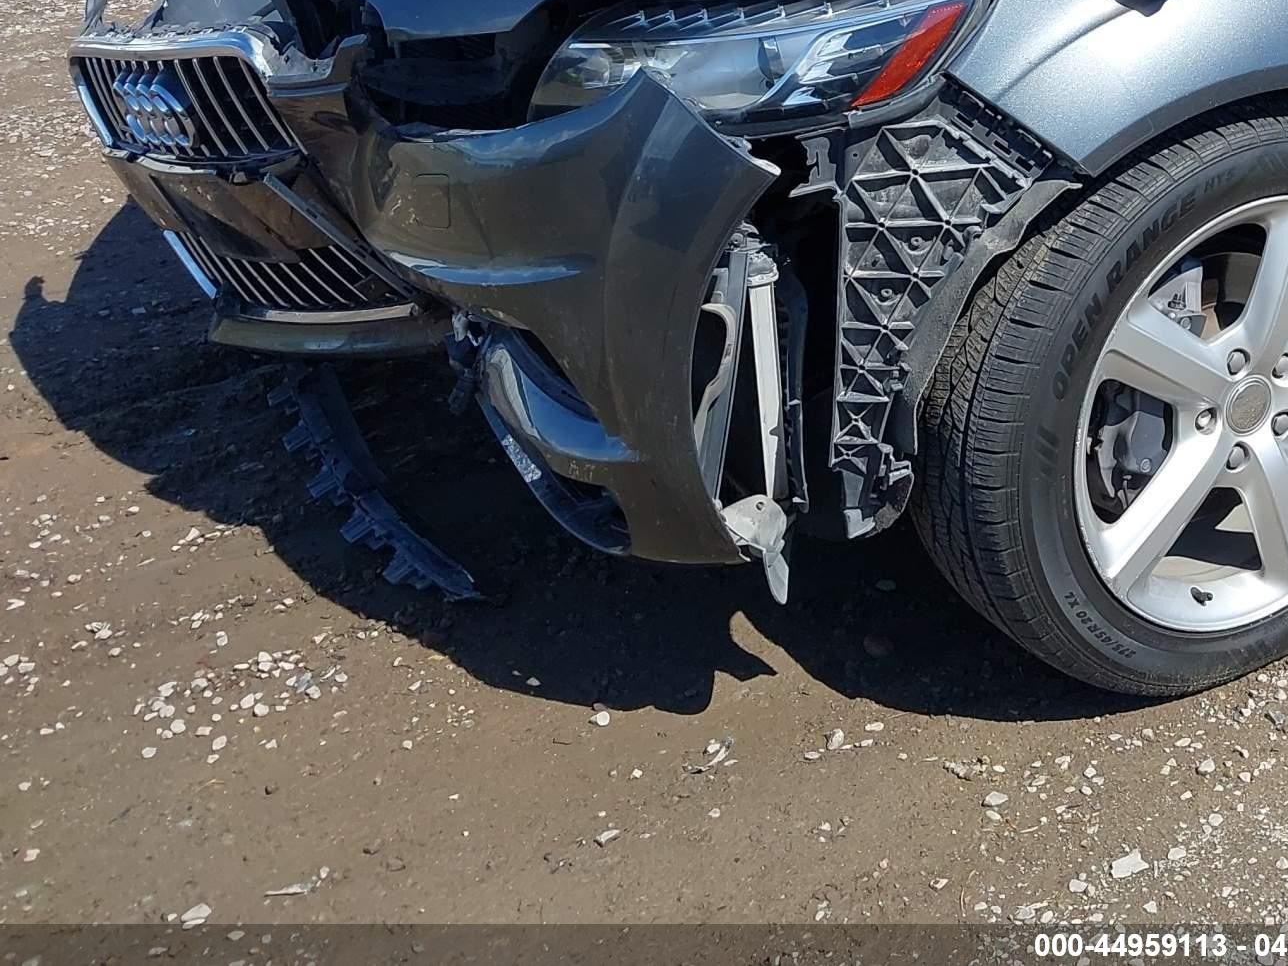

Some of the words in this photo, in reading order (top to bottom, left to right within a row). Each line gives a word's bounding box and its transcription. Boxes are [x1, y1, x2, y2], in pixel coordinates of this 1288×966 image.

[1052, 292, 1104, 401] OPEN
[1104, 191, 1199, 293] RANGE
[1063, 591, 1080, 609] XL
[1075, 610, 1137, 659] 275/45R20
